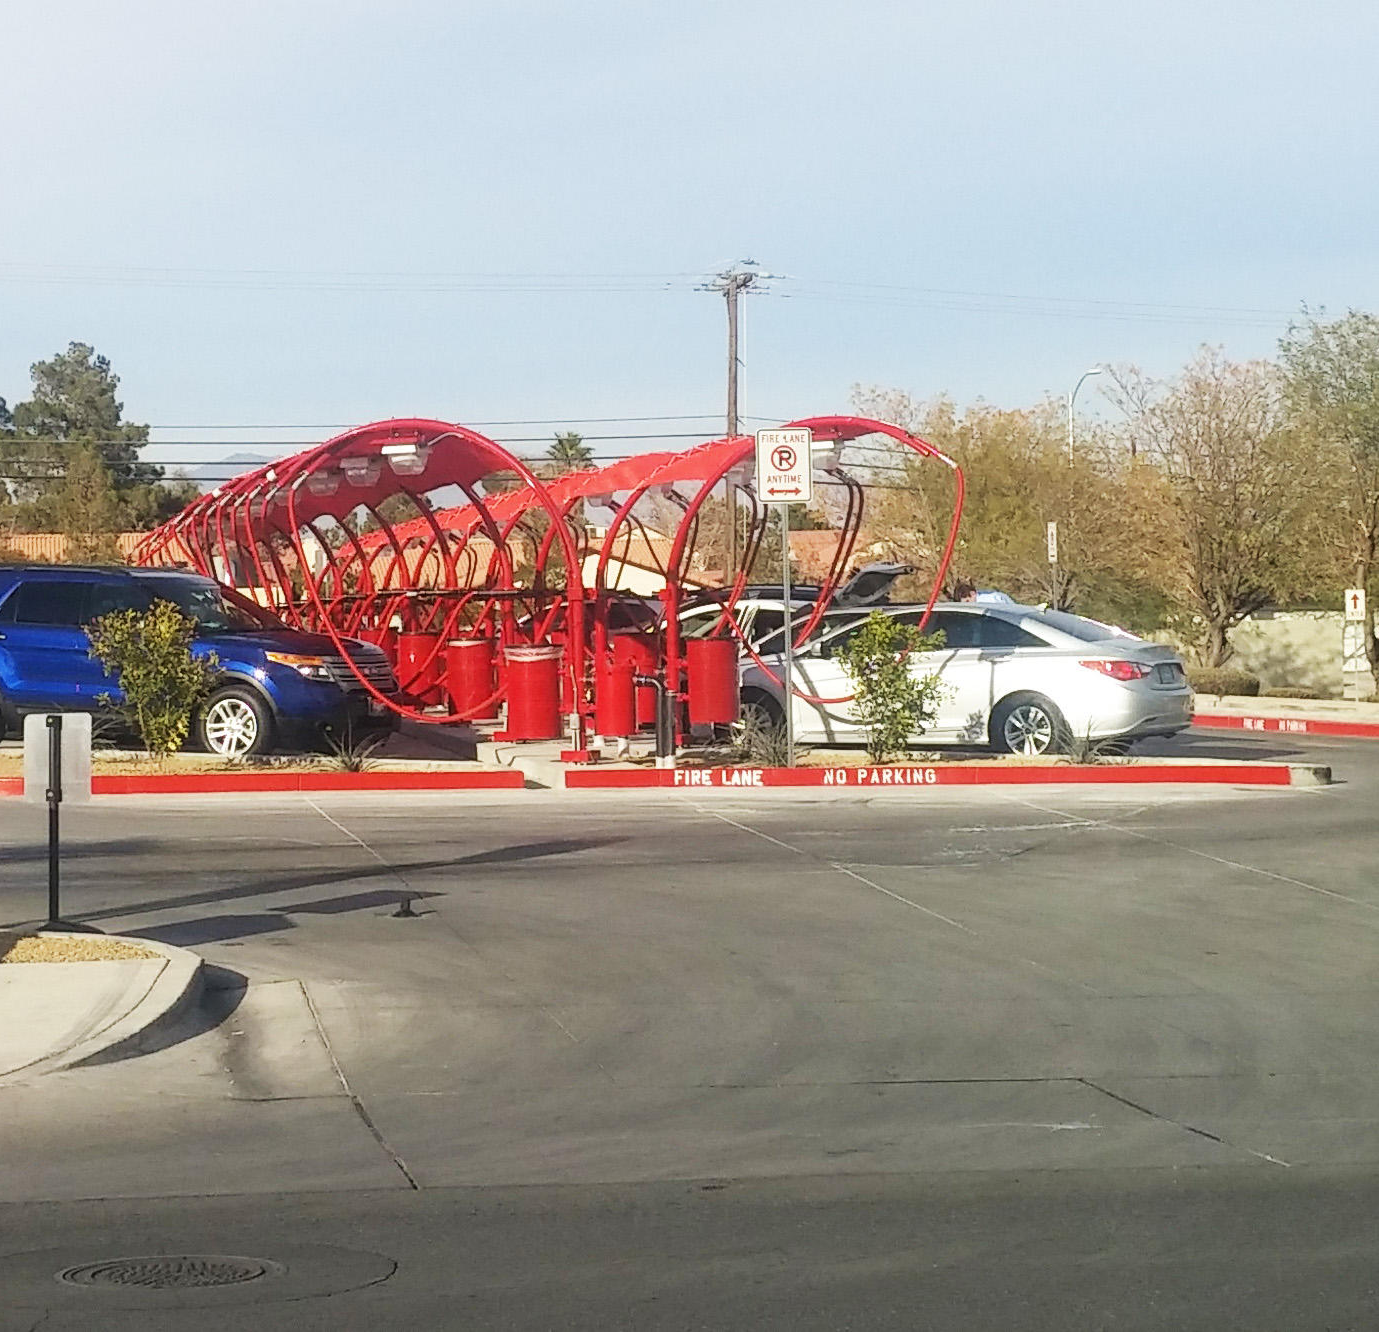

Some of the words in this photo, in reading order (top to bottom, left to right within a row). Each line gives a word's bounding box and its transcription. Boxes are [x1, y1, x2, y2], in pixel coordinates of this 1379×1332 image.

[761, 434, 780, 443] FIRE
[783, 434, 805, 443] LANE
[767, 475, 802, 484] ANYTIME
[674, 769, 712, 786] FIRE
[721, 769, 764, 786] LANE
[823, 768, 847, 785] NO
[857, 768, 937, 784] PARKING
